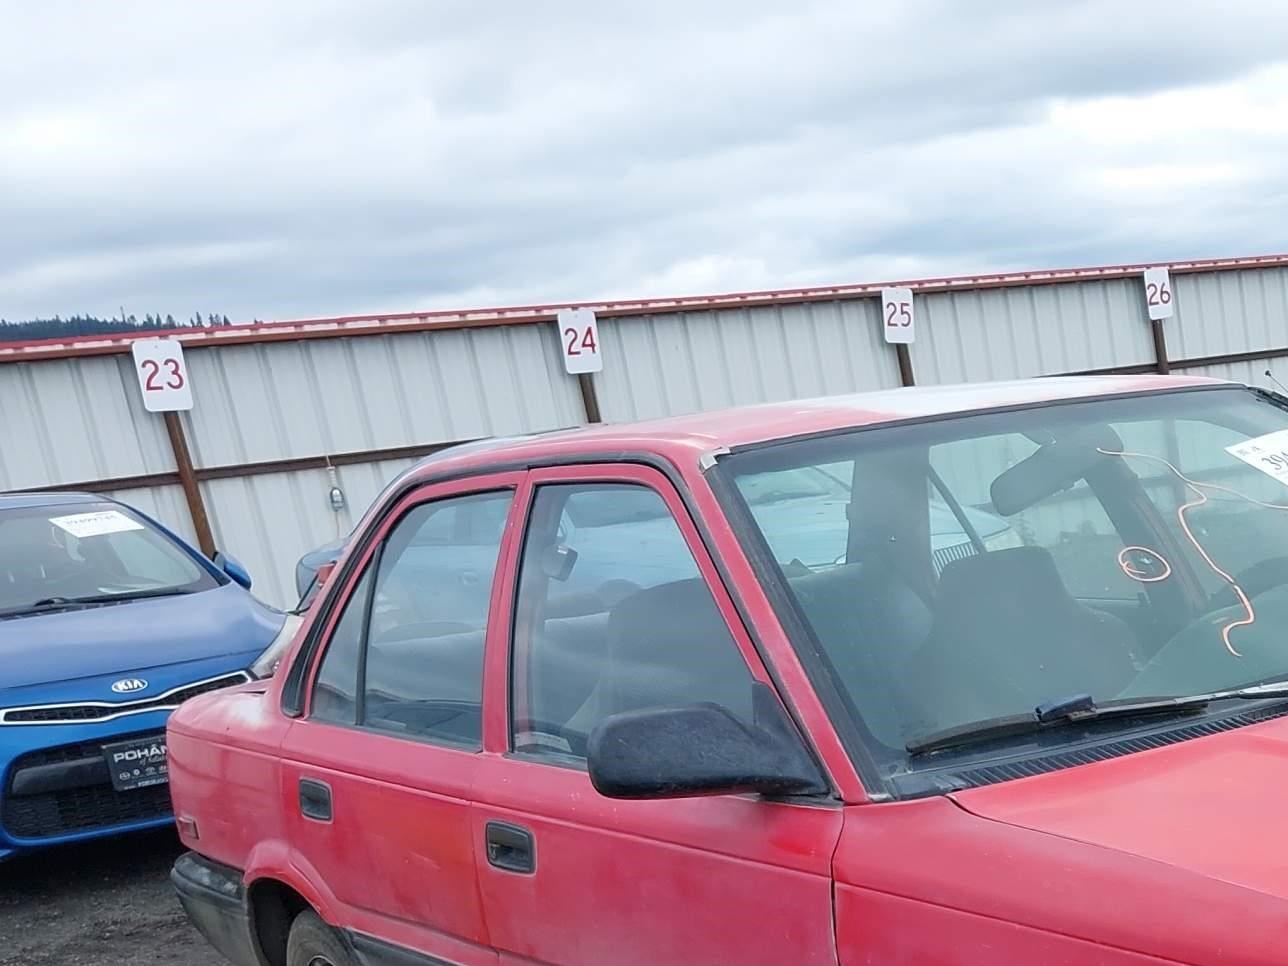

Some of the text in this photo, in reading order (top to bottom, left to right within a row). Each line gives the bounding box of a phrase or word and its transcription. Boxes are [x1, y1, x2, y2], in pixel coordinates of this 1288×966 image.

[1147, 282, 1171, 305] 26
[886, 302, 912, 327] 25
[564, 326, 596, 355] 24
[141, 358, 184, 391] 23
[117, 679, 144, 691] KIA
